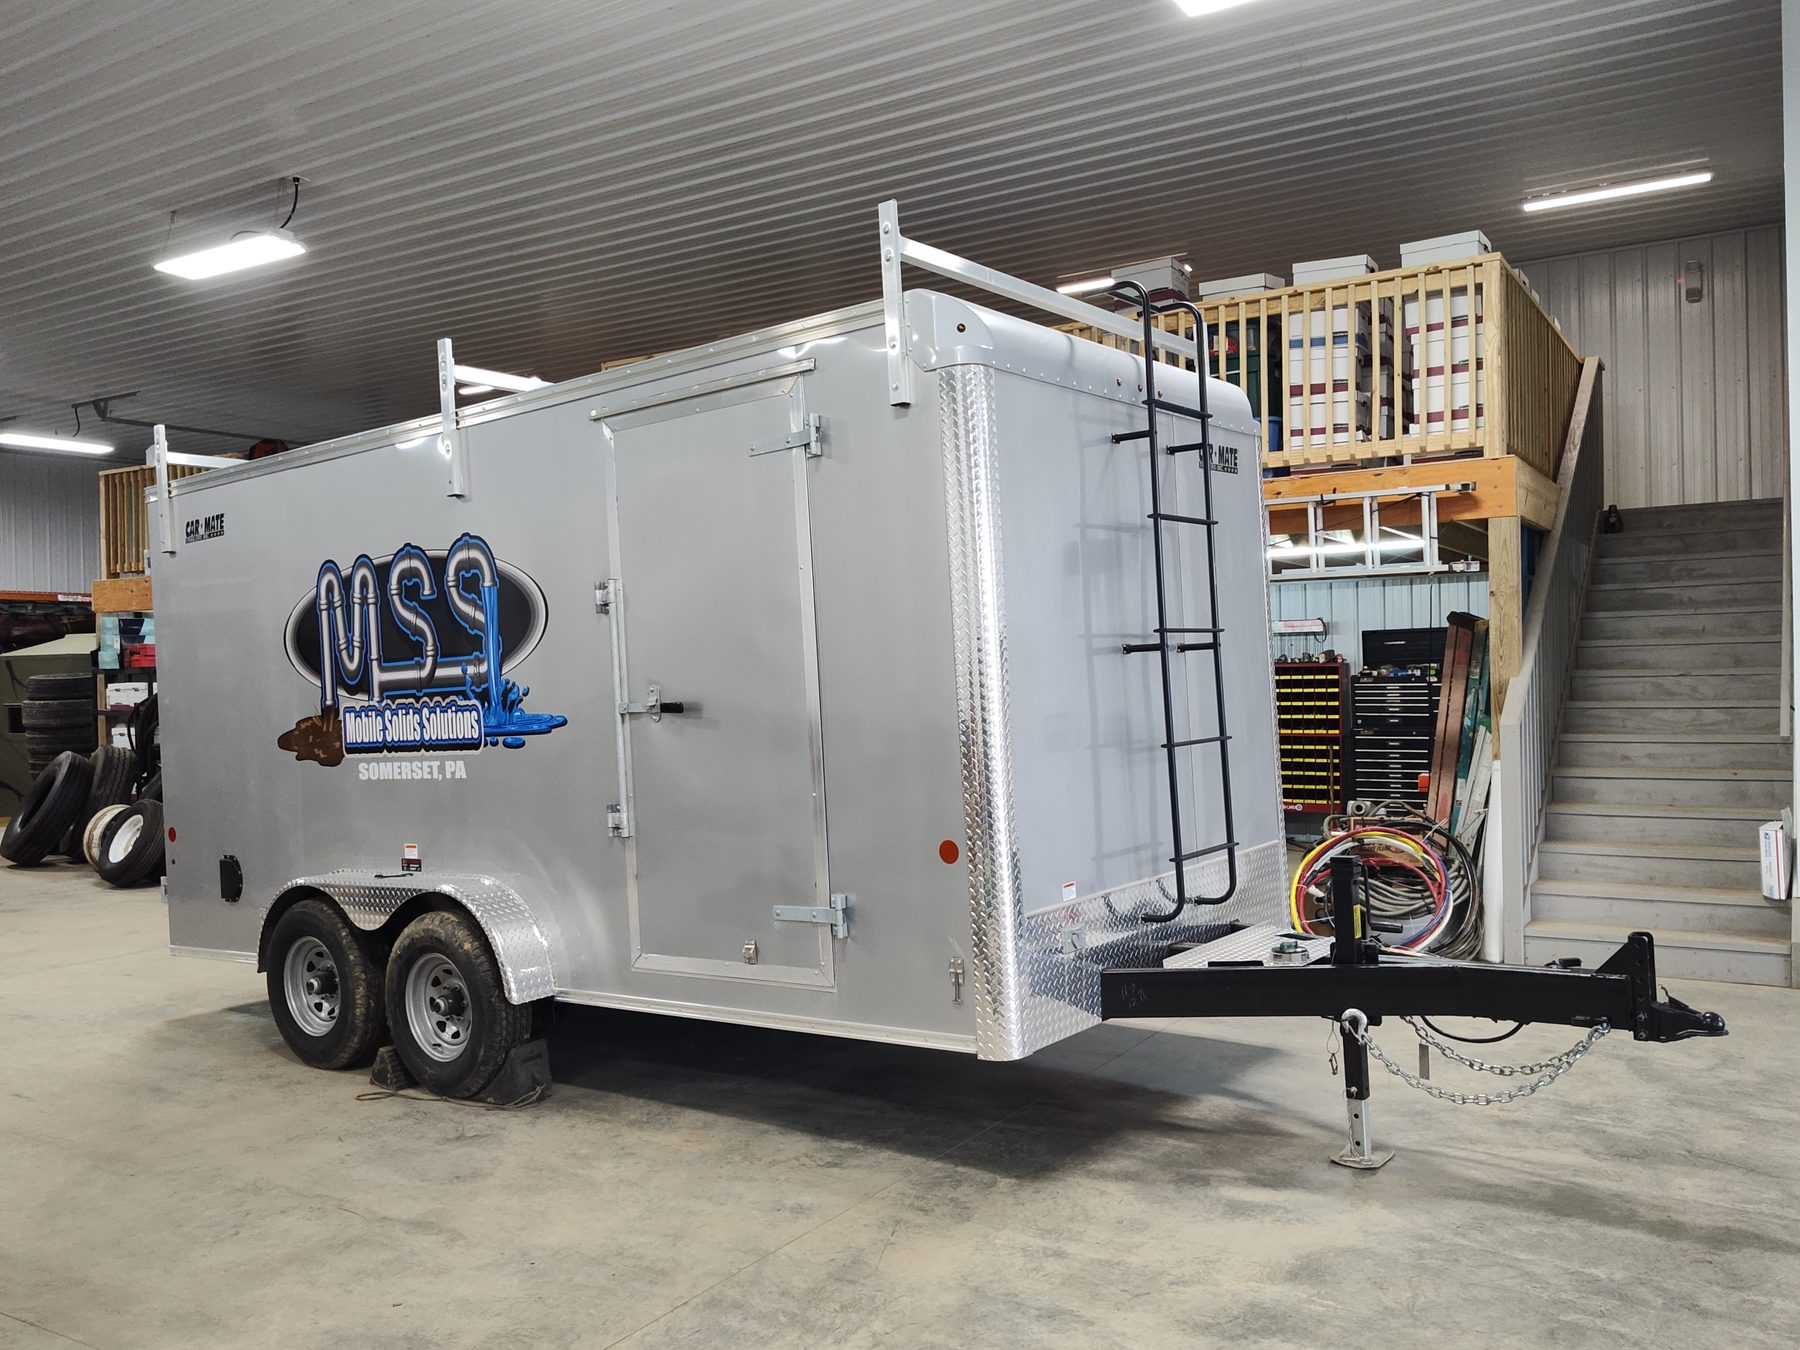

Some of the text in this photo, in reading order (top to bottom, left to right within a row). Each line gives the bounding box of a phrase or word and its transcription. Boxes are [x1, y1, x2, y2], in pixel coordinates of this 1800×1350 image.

[1218, 445, 1238, 467] MATE
[185, 513, 225, 538] CAR MATE
[316, 532, 503, 706] MSS
[345, 705, 480, 744] Mobile Solids Solutions
[358, 760, 468, 781] SOMERSET, PA
